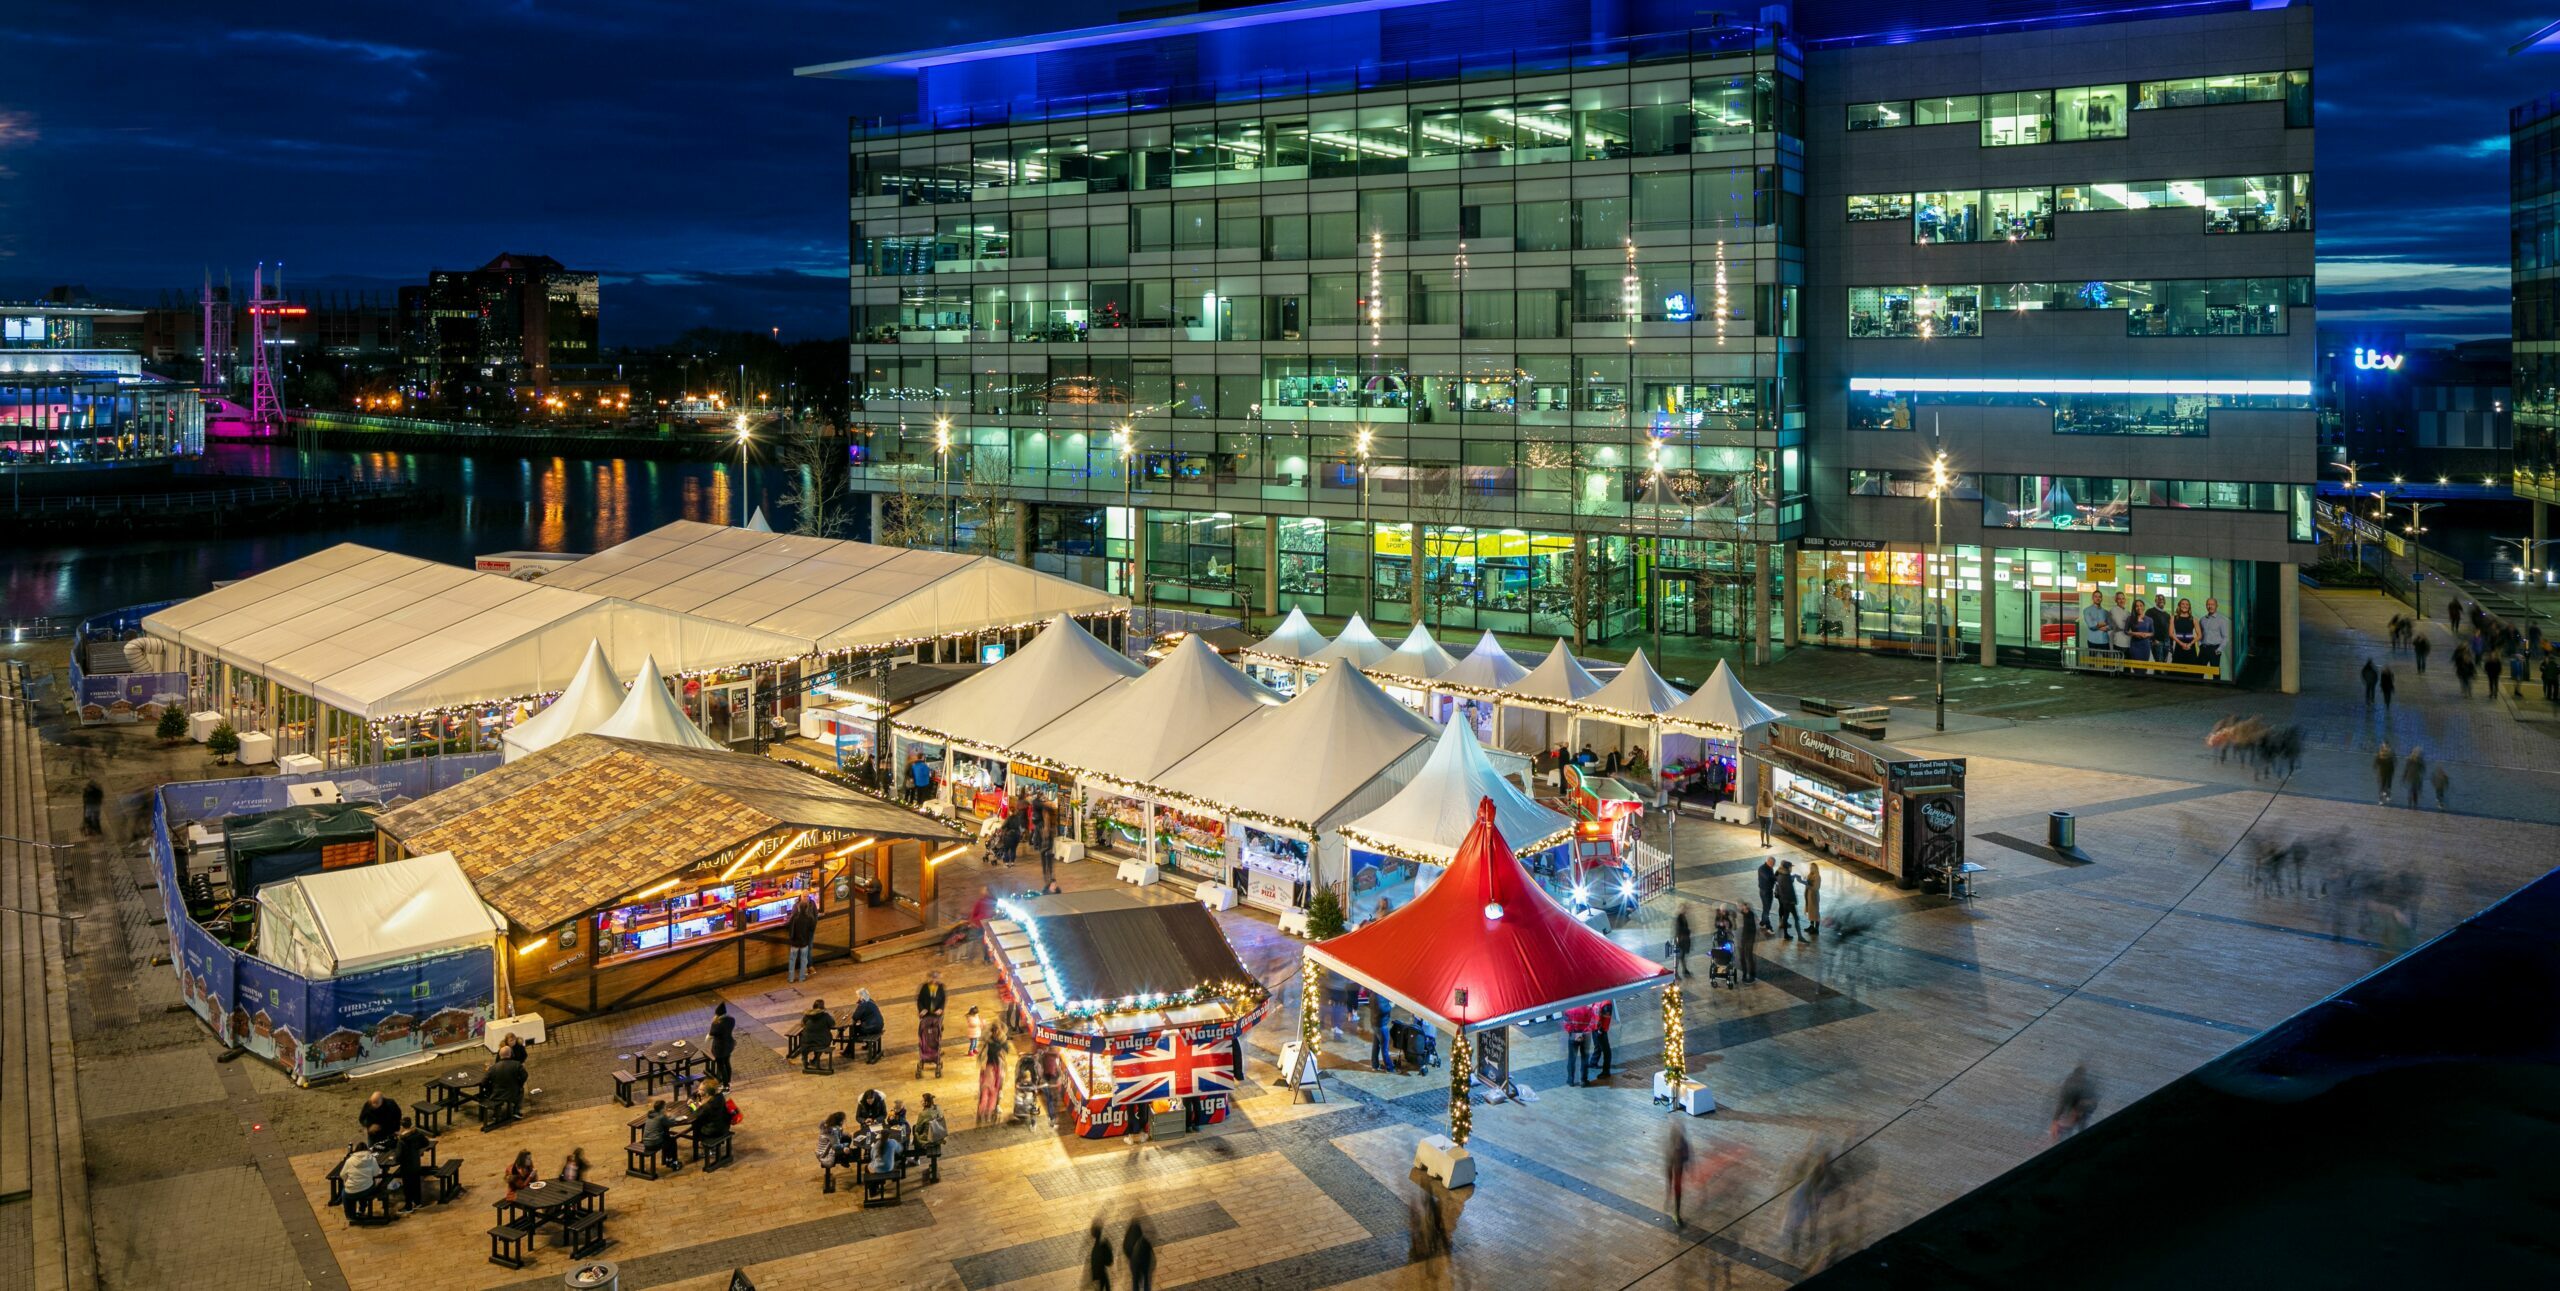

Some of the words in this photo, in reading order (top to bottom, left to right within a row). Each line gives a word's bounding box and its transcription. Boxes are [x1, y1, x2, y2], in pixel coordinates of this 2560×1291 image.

[2355, 348, 2403, 370] itv
[1804, 537, 1824, 545] BBC
[1828, 539, 1849, 547] QUAY
[1800, 731, 1835, 759] Carvery
[1921, 803, 1956, 825] Carvery
[1261, 889, 1276, 898] PIZZA
[338, 999, 392, 1014] CHRISTMAS
[1036, 1026, 1092, 1048] Homemade
[1104, 1035, 1153, 1052] Fudge
[1080, 1108, 1128, 1127] Fudg
